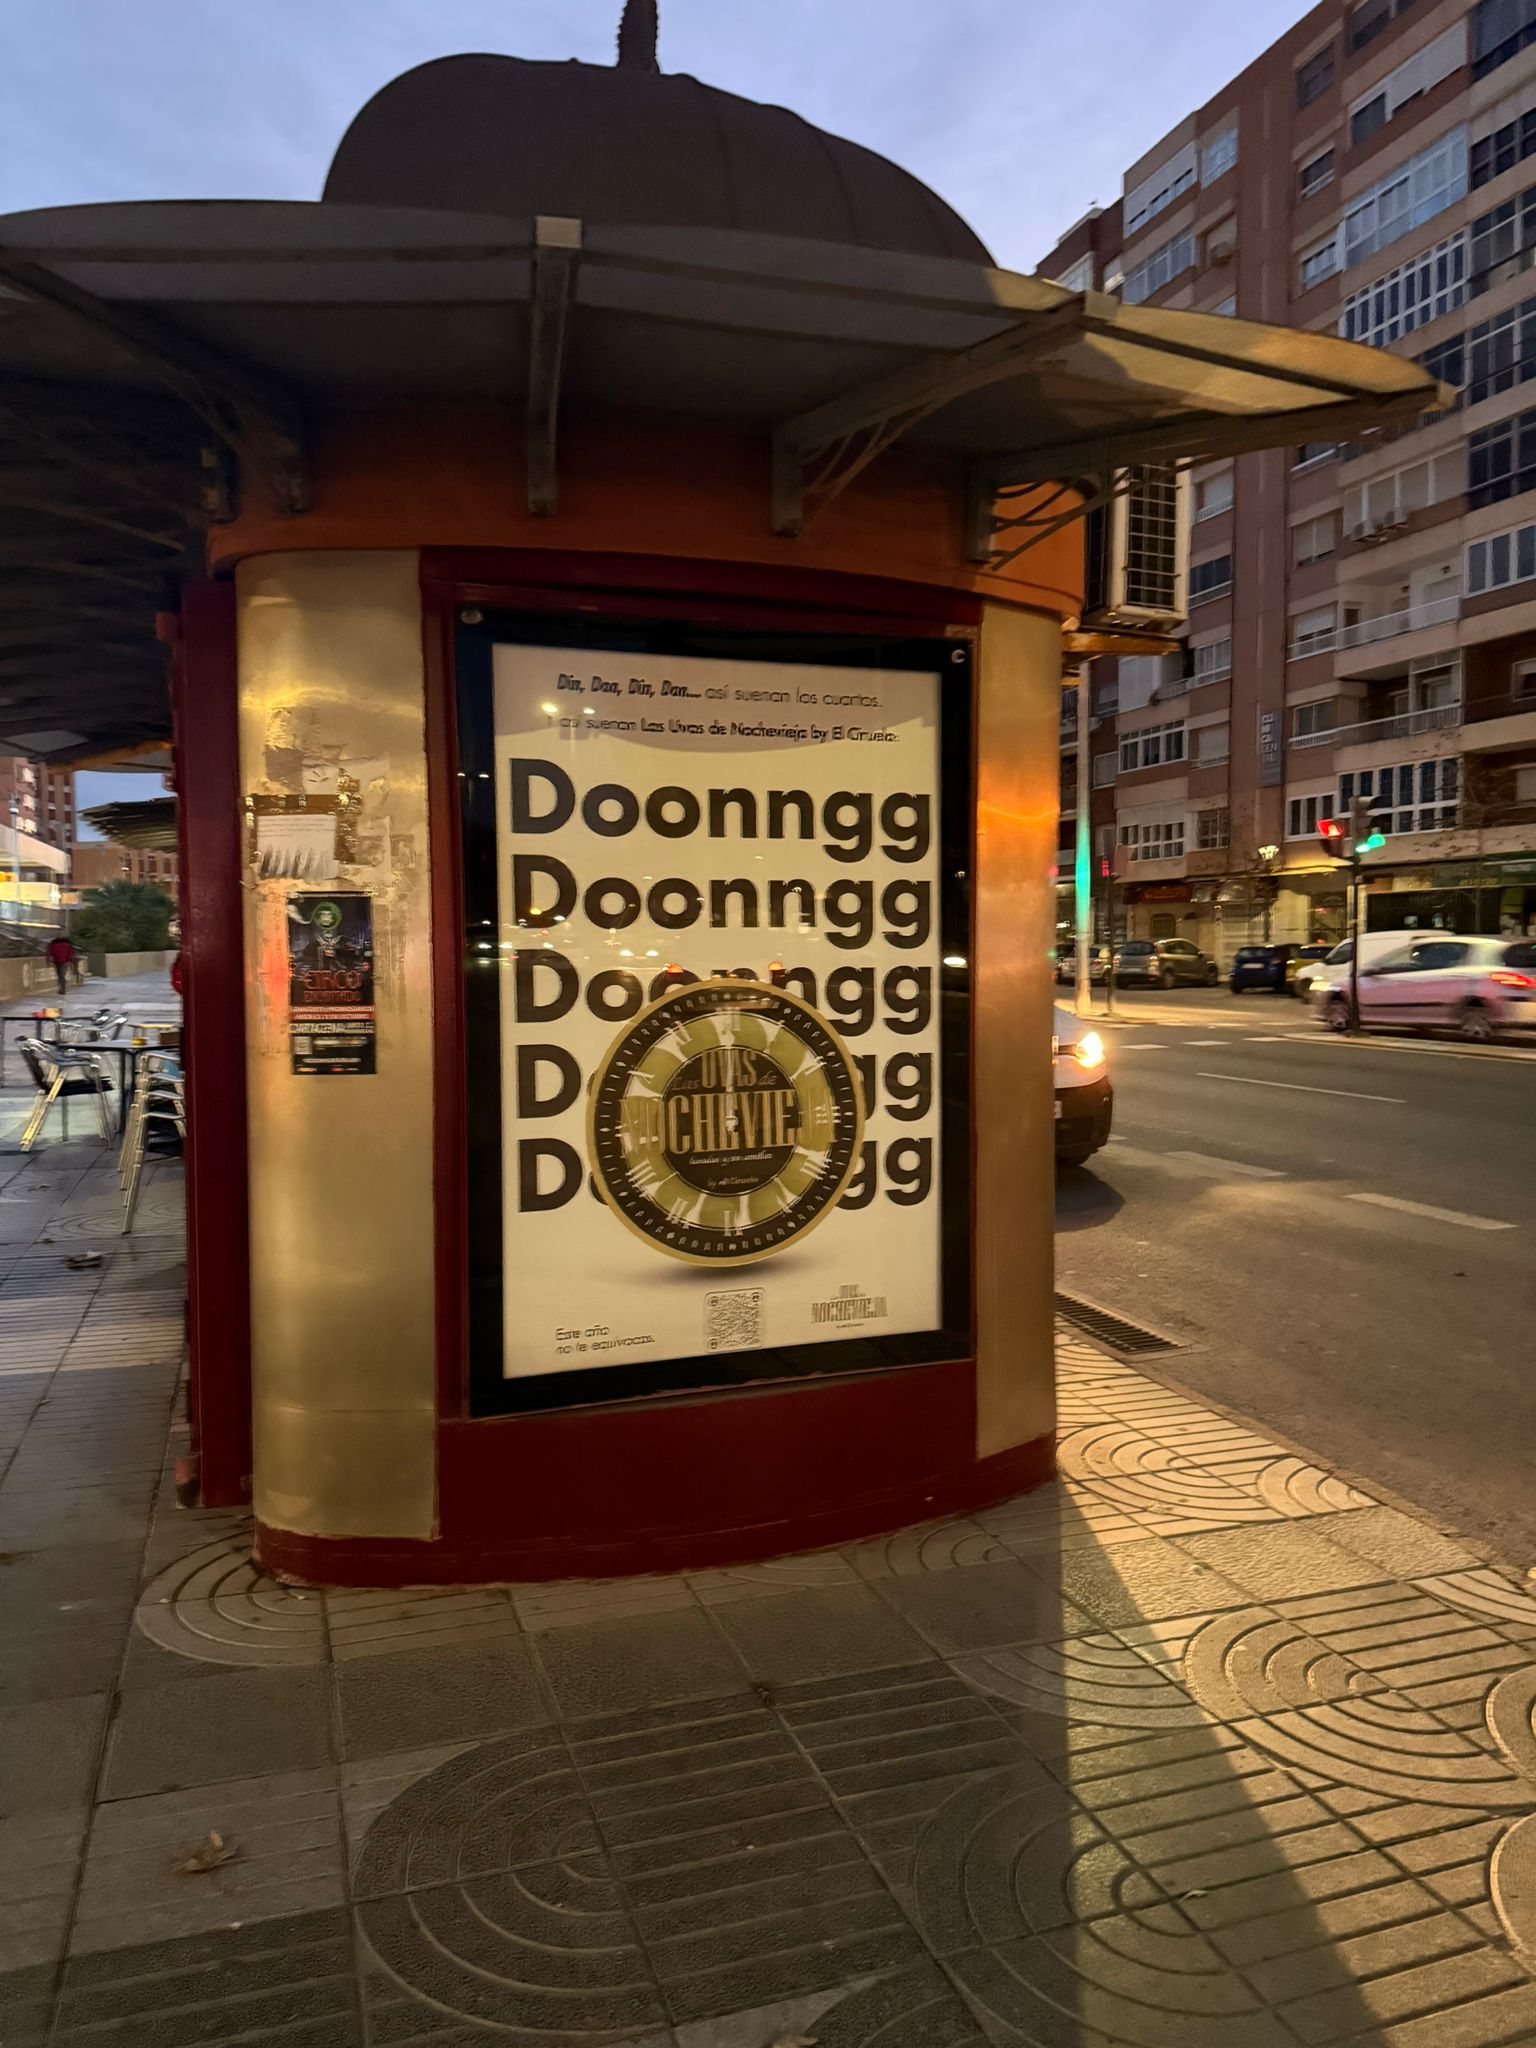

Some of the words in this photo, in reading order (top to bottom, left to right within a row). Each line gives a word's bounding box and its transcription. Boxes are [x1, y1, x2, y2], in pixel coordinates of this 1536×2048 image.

[705, 684, 729, 699] así
[735, 688, 790, 703] suenan
[796, 686, 818, 704] los
[586, 718, 636, 731] suenan
[641, 718, 665, 733] Las
[668, 719, 705, 734] Uvas
[708, 720, 727, 735] de
[810, 724, 828, 743] by
[509, 758, 931, 863] Doonngg
[512, 854, 932, 949] Doonngg
[515, 948, 933, 1037] Dongg
[759, 1071, 777, 1087] de
[584, 1324, 609, 1337] año
[556, 1345, 574, 1354] no
